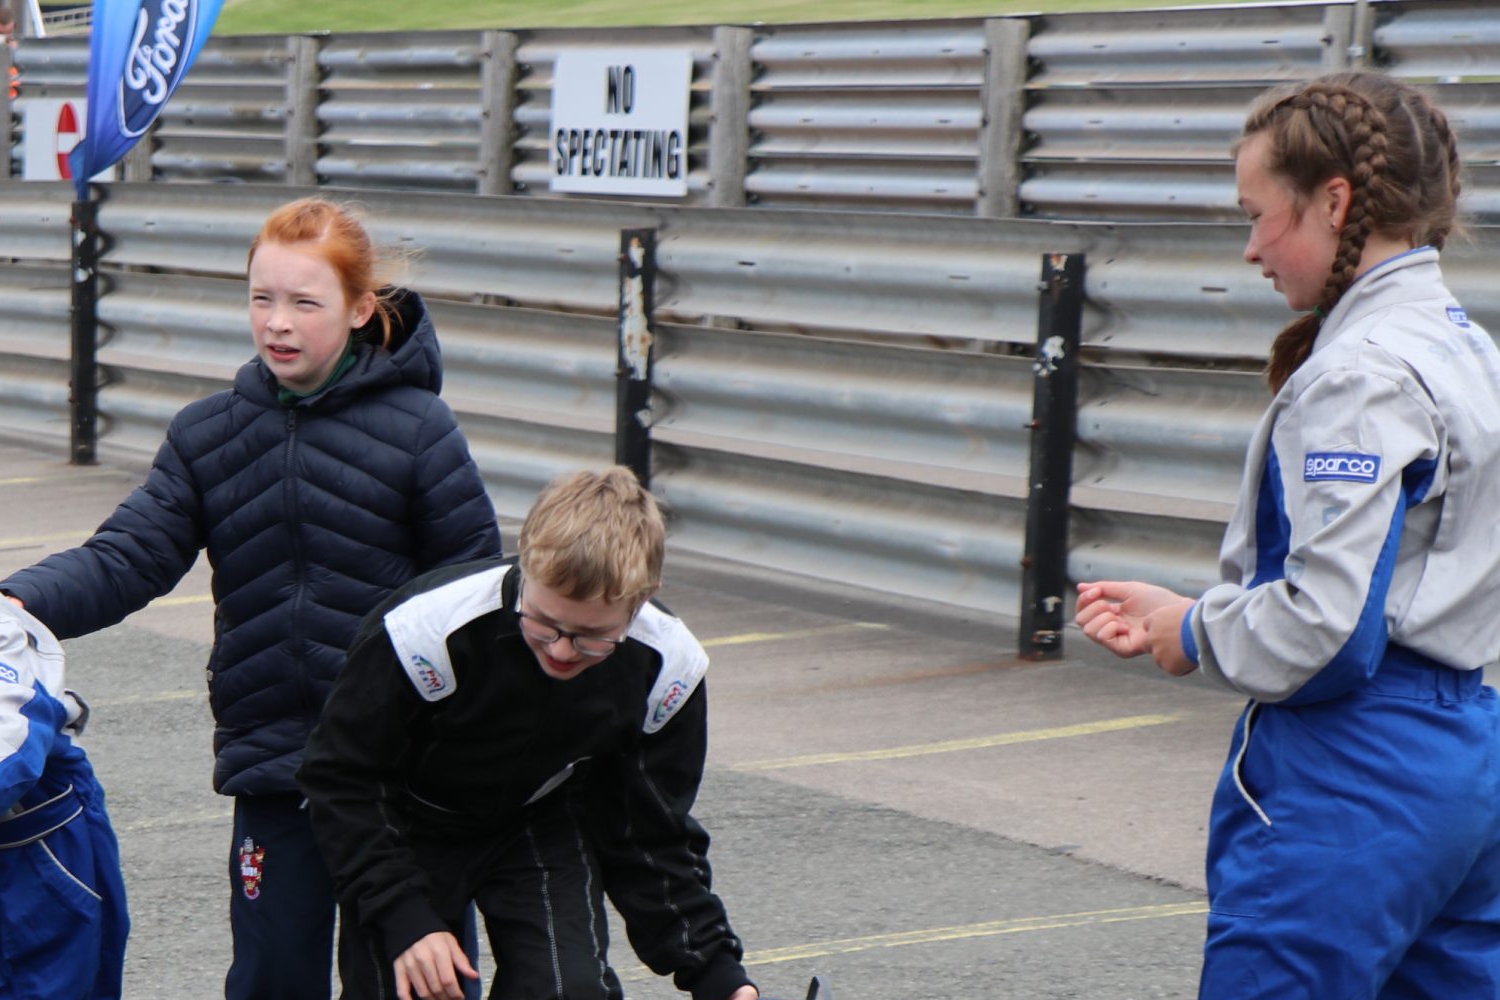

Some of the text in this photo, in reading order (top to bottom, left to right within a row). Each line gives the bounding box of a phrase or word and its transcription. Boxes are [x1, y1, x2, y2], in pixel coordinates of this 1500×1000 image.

[606, 64, 636, 114] NO
[556, 127, 683, 180] SPECTATING
[1305, 456, 1376, 477] sparco
